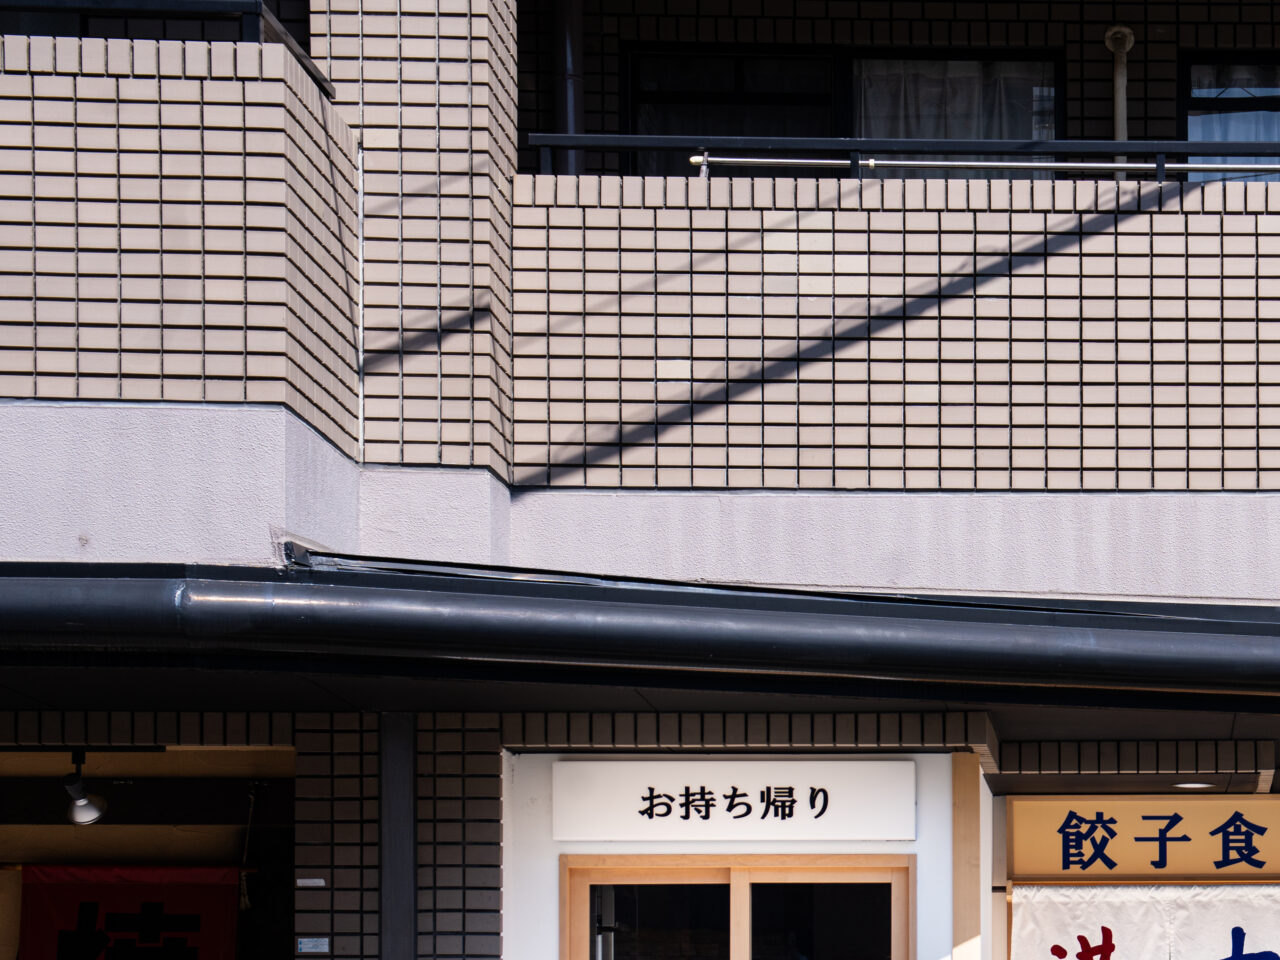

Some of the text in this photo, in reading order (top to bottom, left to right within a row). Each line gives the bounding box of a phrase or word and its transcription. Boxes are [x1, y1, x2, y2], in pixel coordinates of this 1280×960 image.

[638, 786, 830, 821] お持ち帰り
